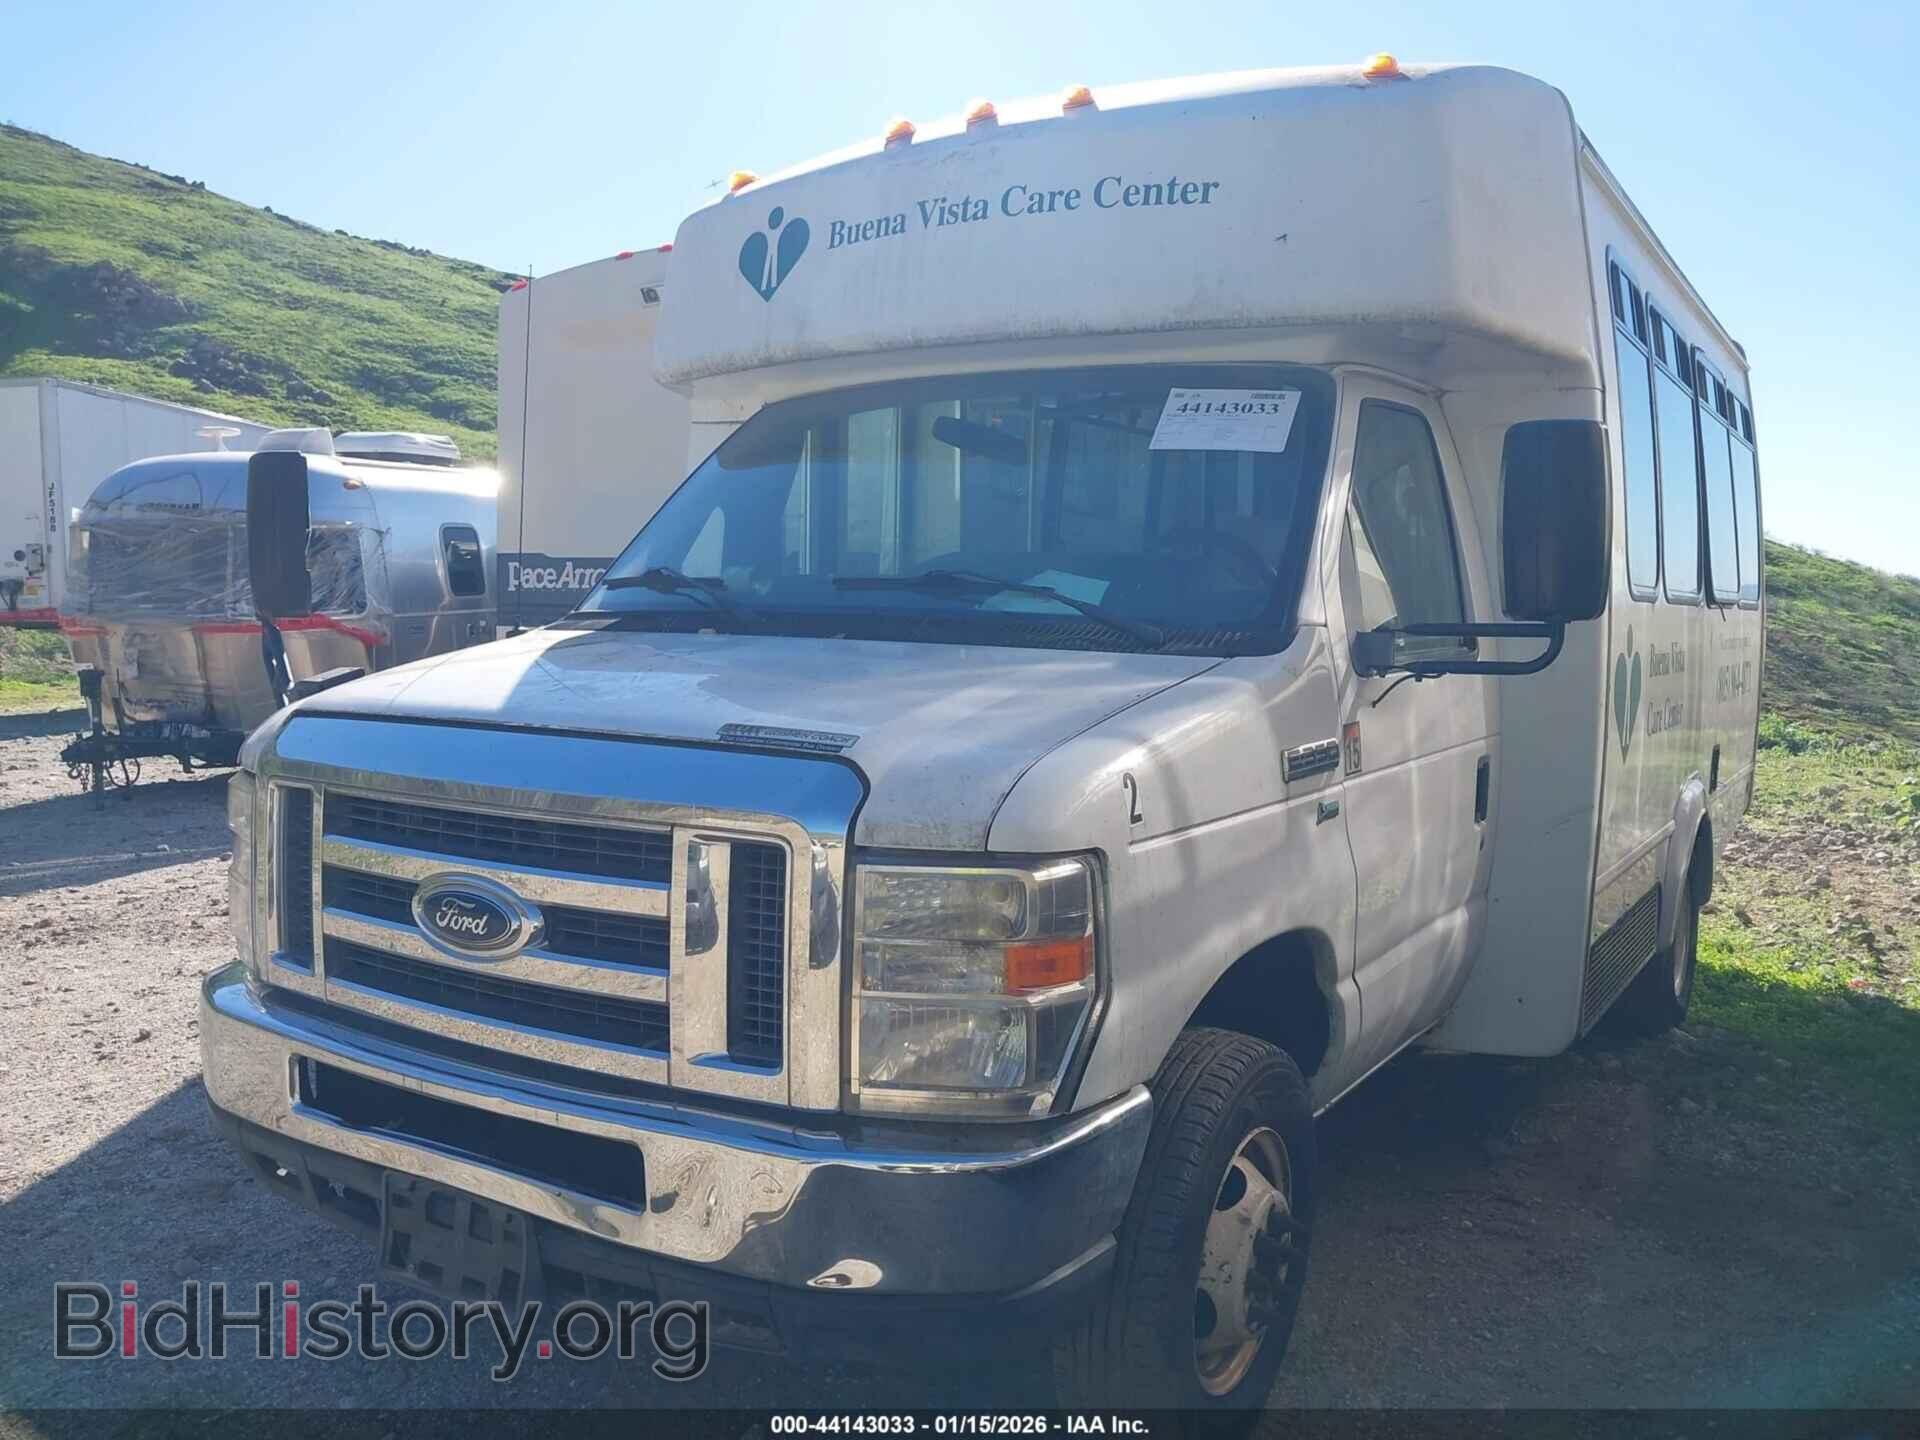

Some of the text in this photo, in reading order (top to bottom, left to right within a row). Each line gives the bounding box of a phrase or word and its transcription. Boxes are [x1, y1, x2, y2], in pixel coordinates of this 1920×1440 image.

[826, 175, 1220, 249] Buena Vista Care Center
[1176, 402, 1280, 415] 44143033
[1122, 772, 1143, 824] 2
[436, 897, 489, 935] Ford
